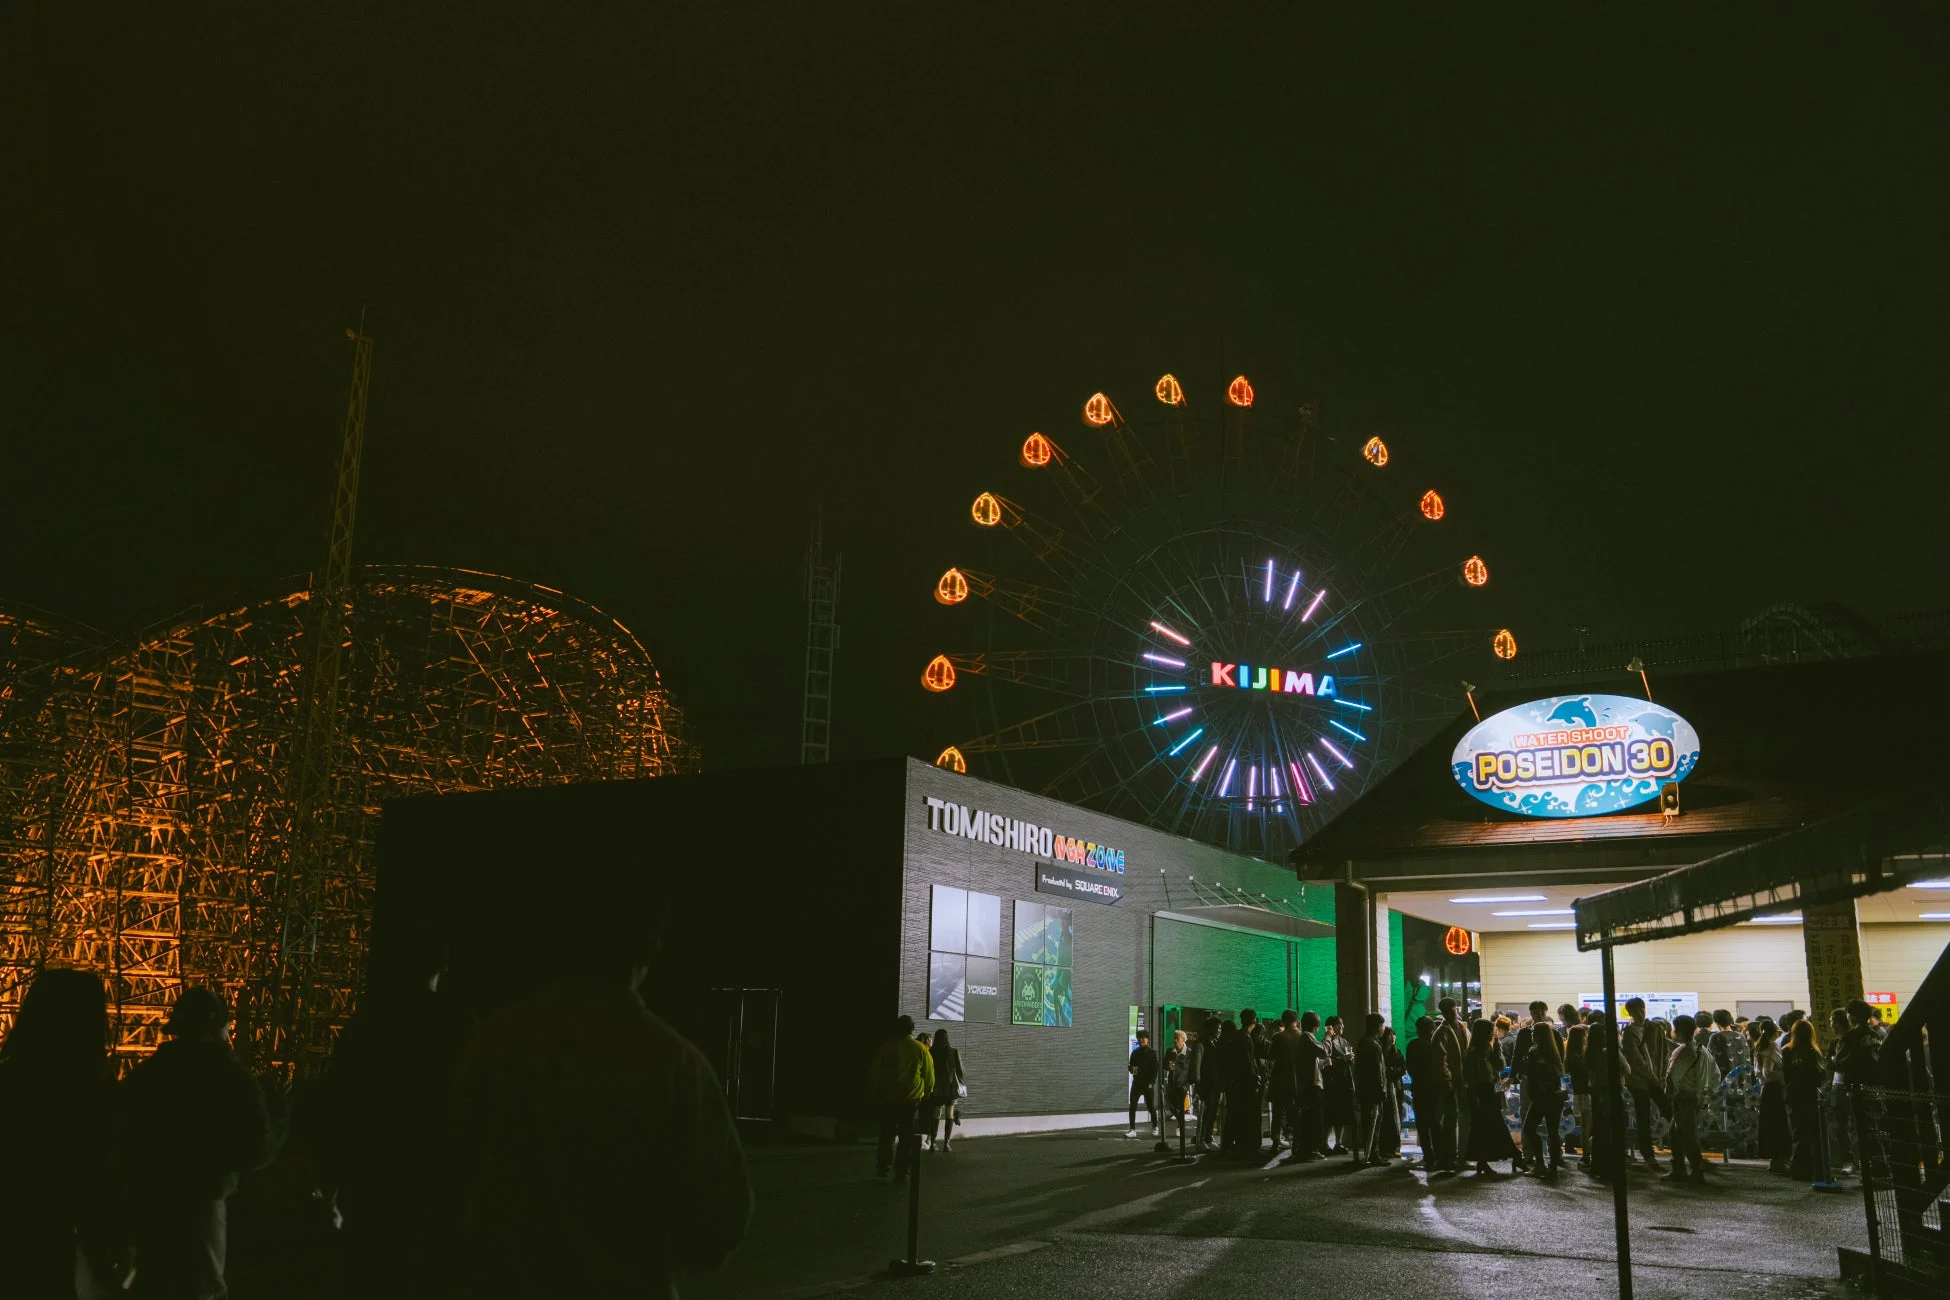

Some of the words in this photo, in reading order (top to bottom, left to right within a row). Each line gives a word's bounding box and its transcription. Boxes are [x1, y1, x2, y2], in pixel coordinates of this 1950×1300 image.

[1211, 661, 1339, 698] KIJIMA
[1514, 730, 1571, 748] WATER
[1572, 725, 1629, 743] SHOOT
[1478, 743, 1624, 783] POSEIDON
[1629, 739, 1671, 772] 30
[927, 796, 1053, 859] TOMISHIRO
[1042, 874, 1065, 888] Produced
[1075, 879, 1103, 896] SQUARE
